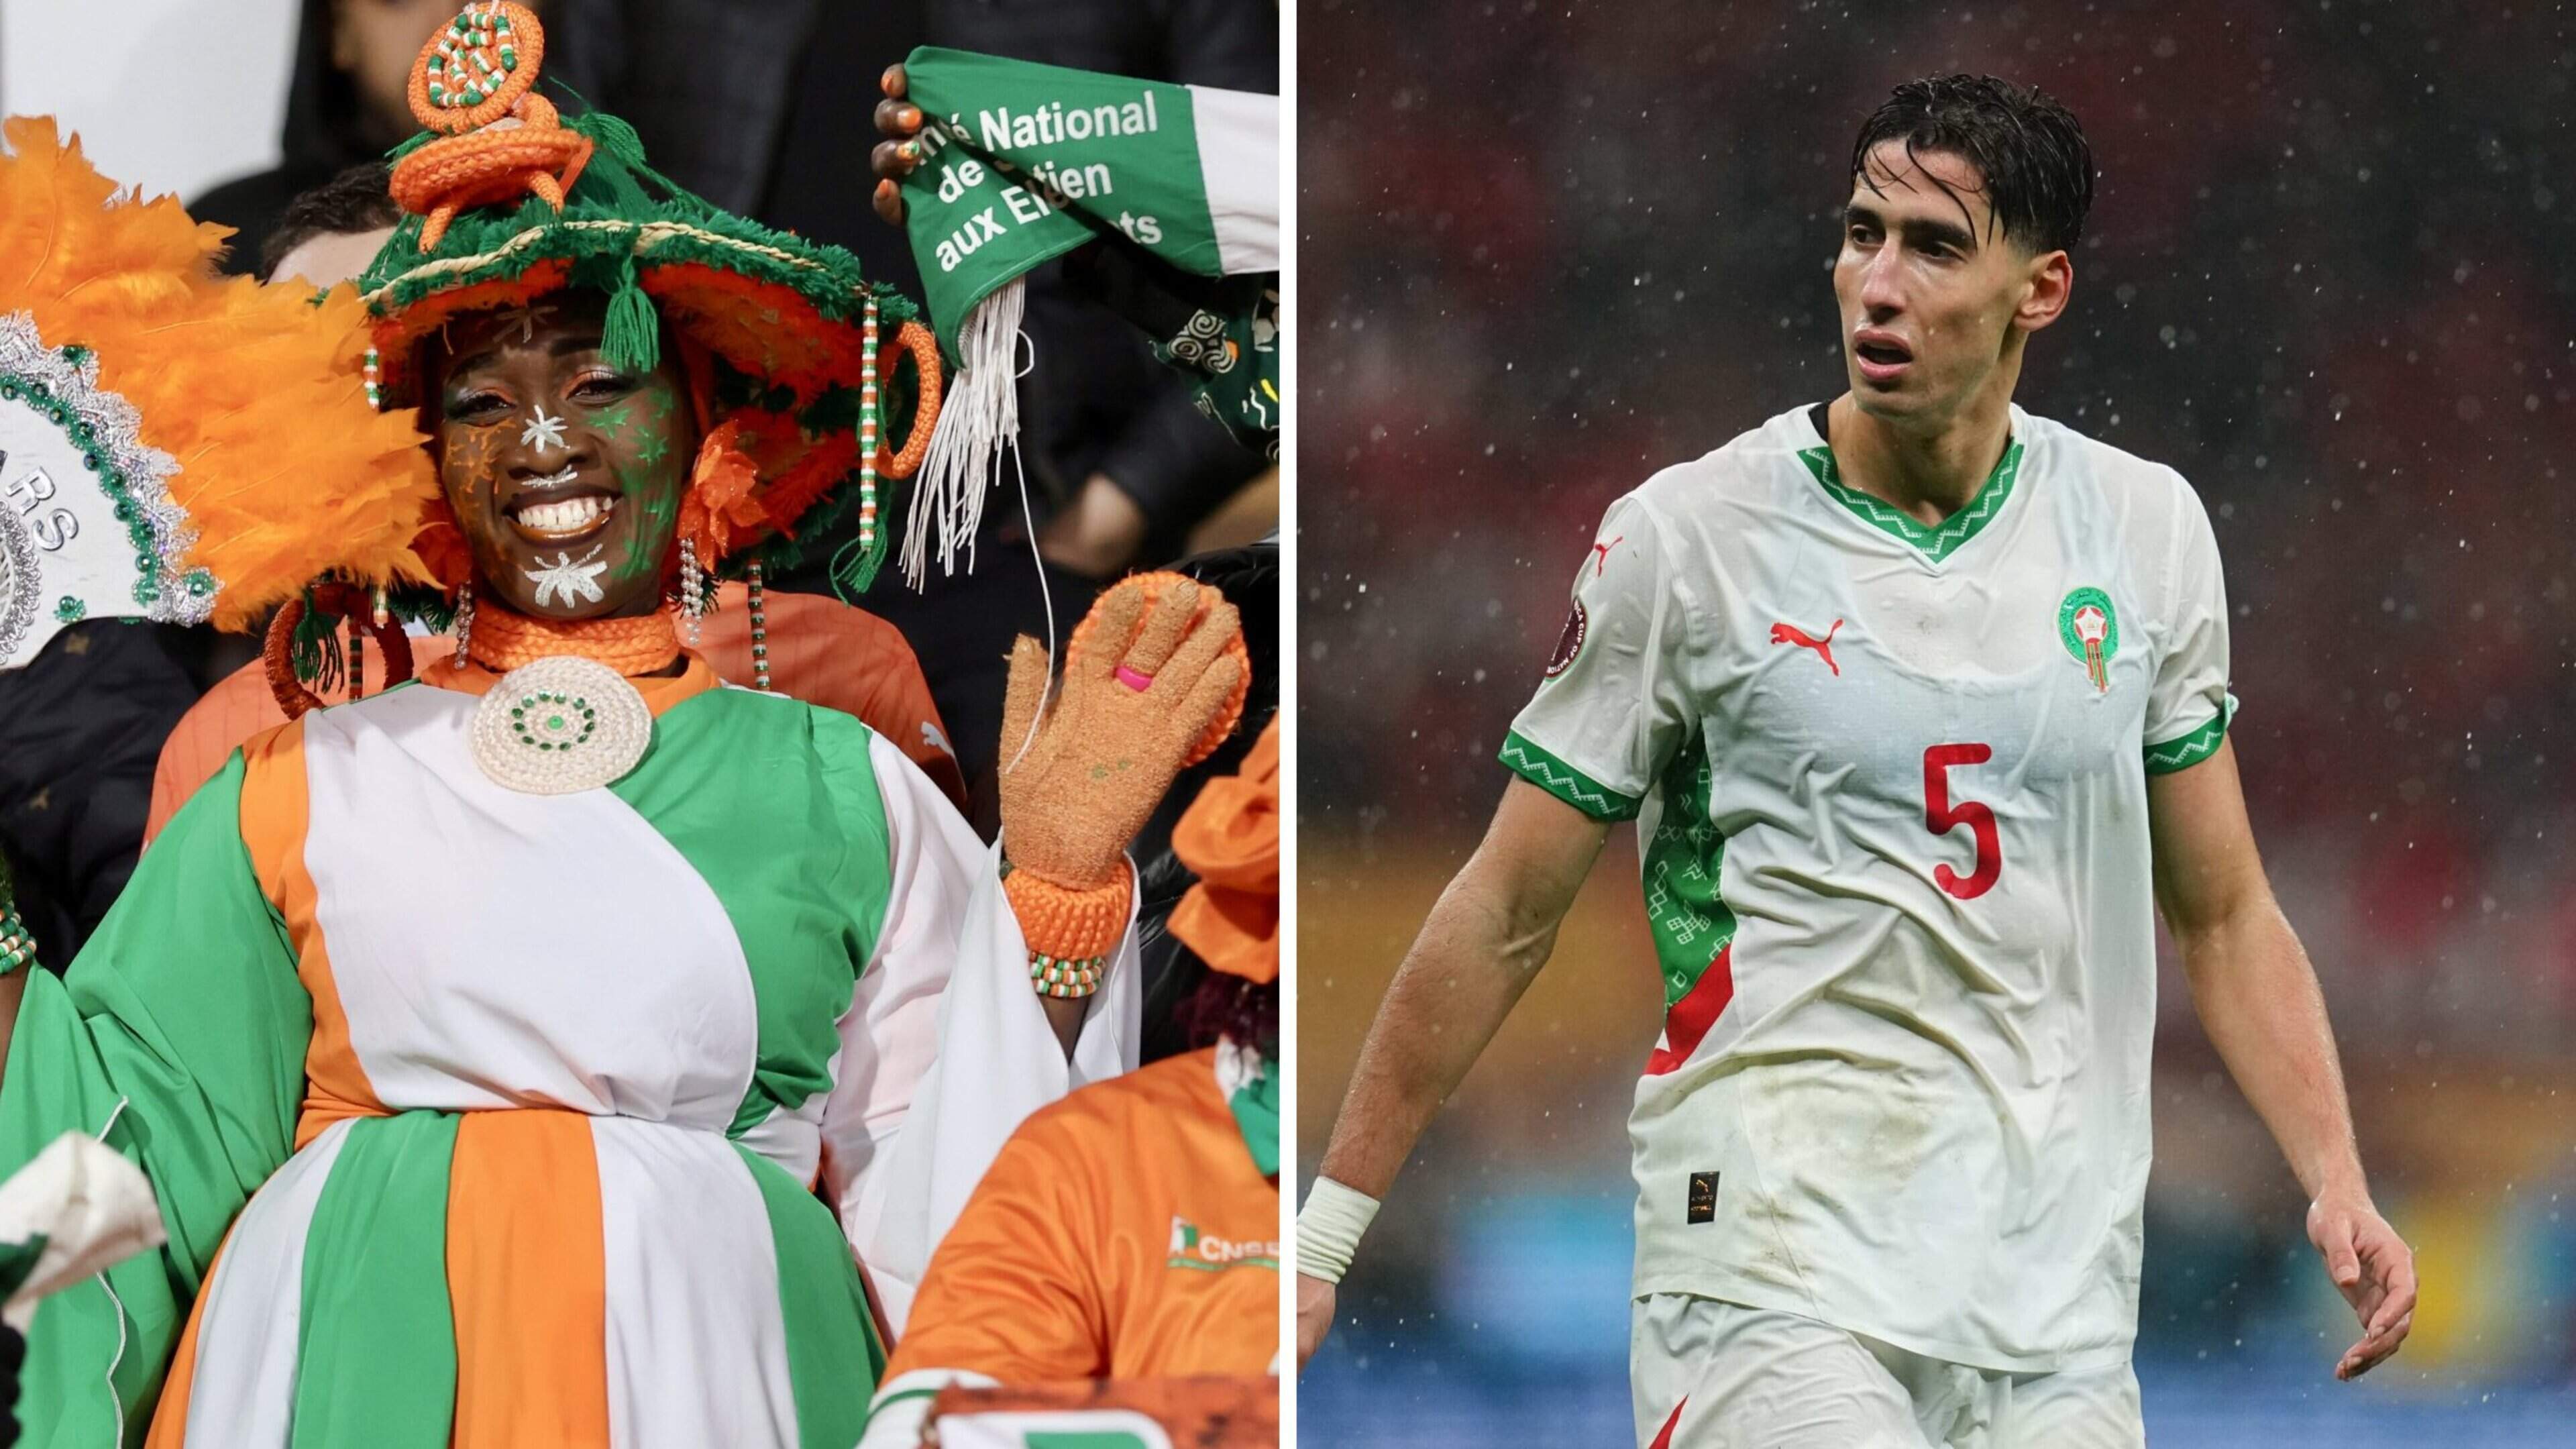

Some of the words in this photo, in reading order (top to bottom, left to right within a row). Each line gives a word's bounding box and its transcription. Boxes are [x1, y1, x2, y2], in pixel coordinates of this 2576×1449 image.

[979, 90, 1158, 152] National
[938, 160, 985, 204] de
[935, 206, 1008, 272] aux
[1923, 743, 2002, 900] 5
